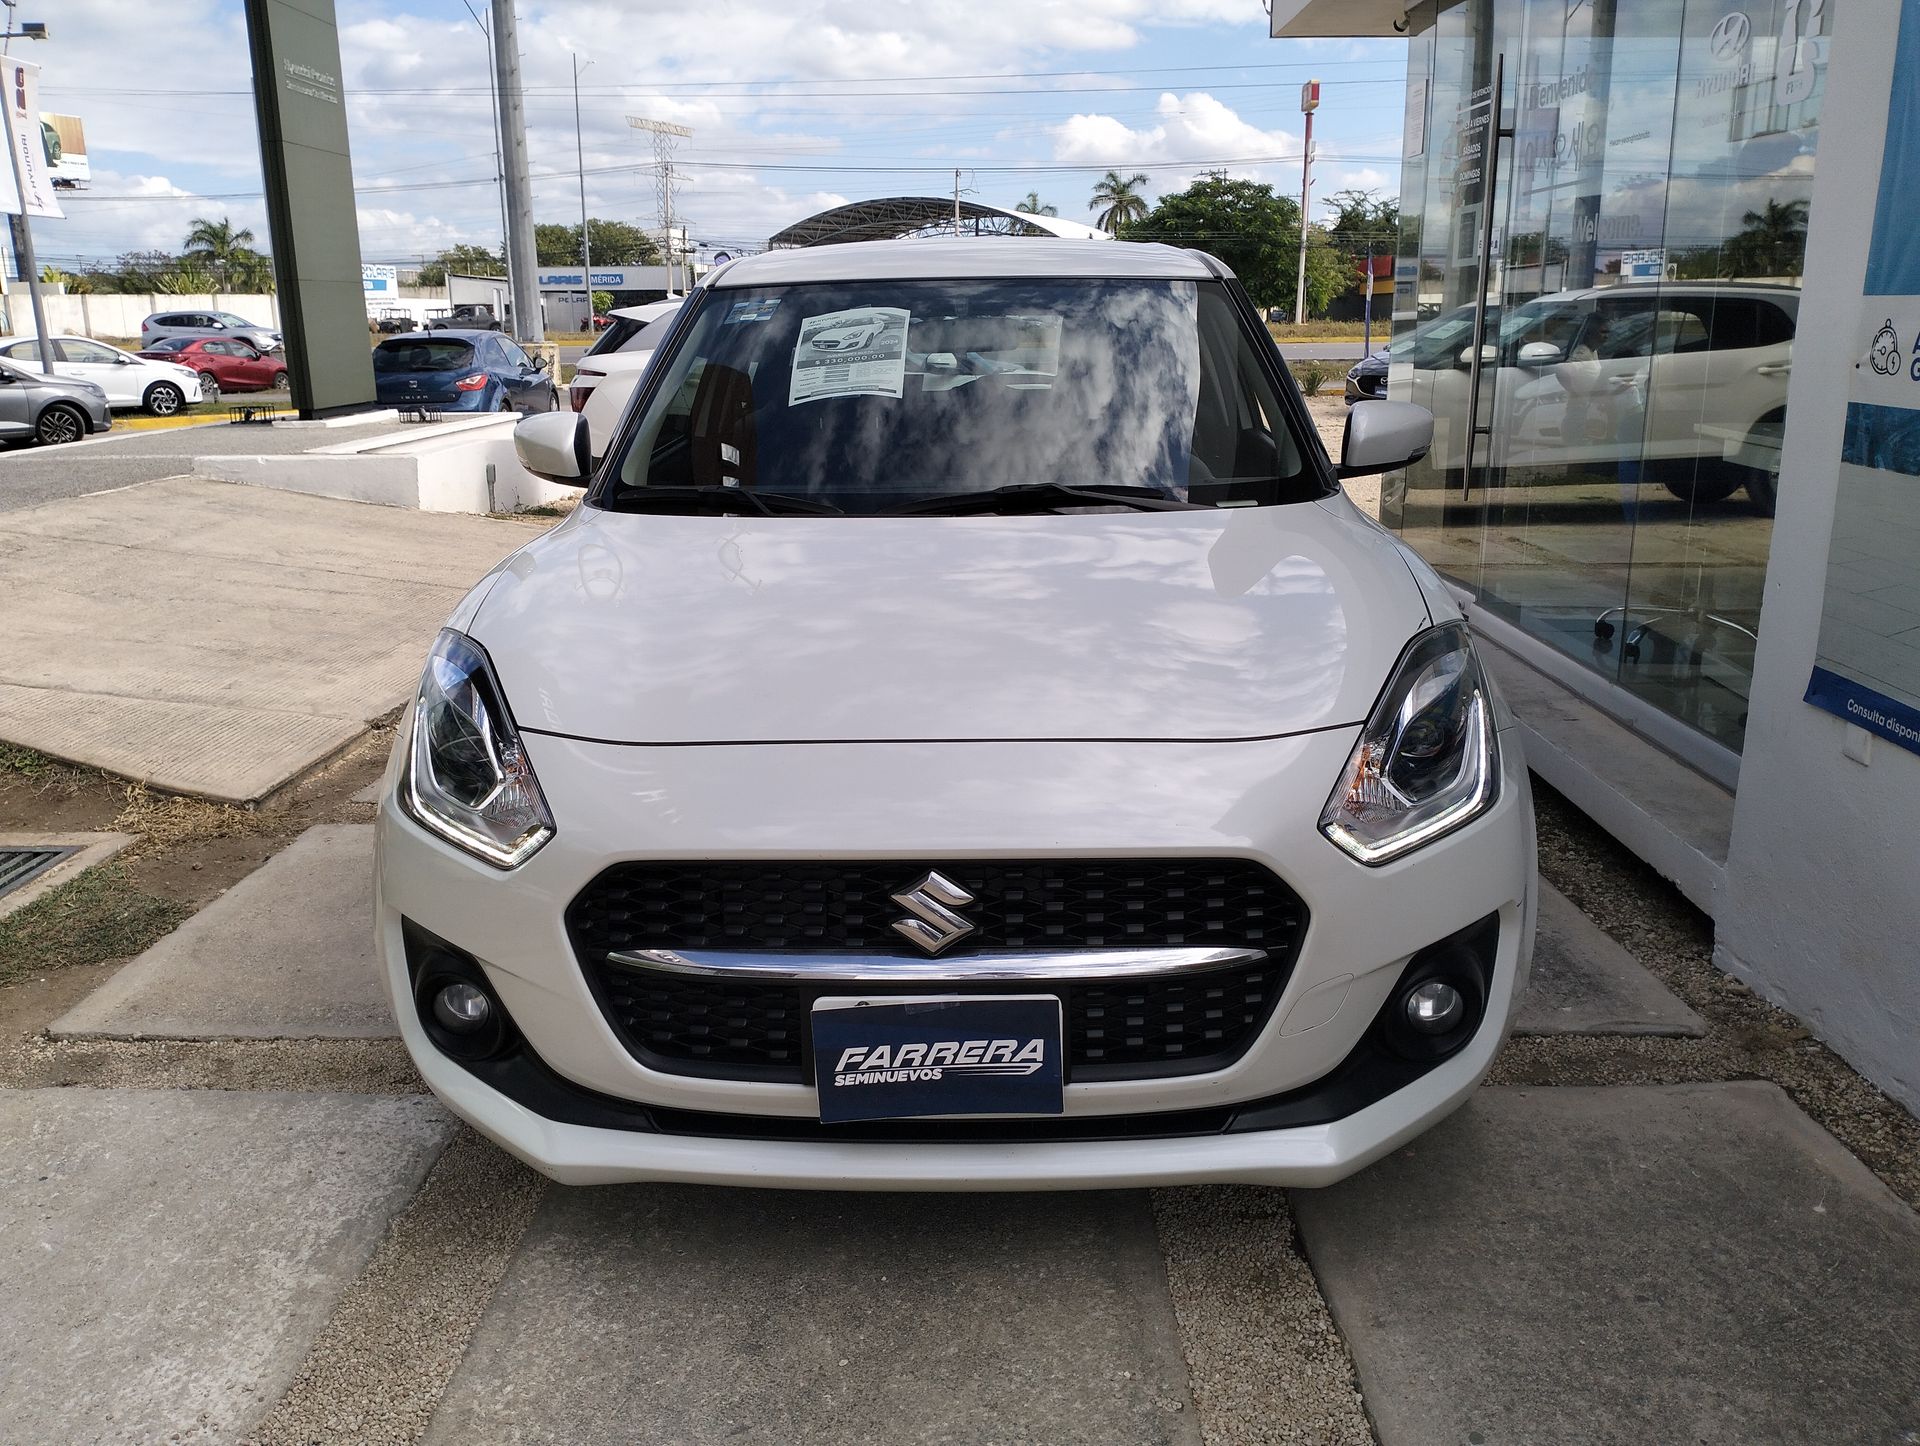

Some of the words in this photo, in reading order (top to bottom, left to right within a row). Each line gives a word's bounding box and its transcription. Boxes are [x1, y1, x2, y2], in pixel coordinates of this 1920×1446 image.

[20, 134, 37, 189] HYUNDAI
[539, 275, 583, 285] LARIS
[824, 353, 885, 364] 330,000.00
[1847, 699, 1885, 726] Consulta
[834, 1038, 1045, 1072] FARRERA
[834, 1068, 943, 1087] SEMINUEVOS
